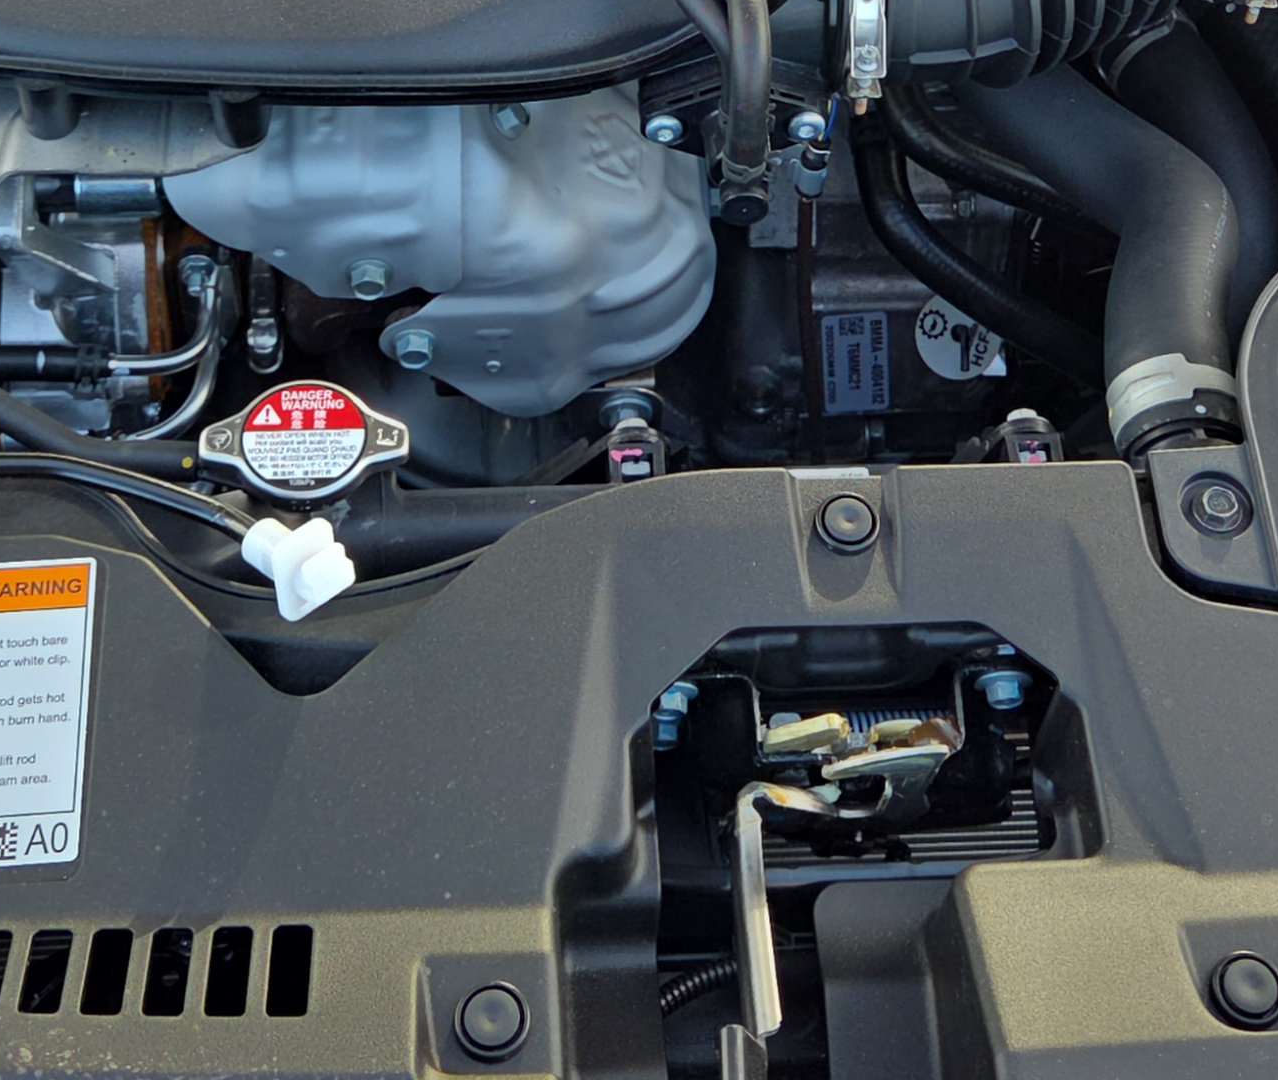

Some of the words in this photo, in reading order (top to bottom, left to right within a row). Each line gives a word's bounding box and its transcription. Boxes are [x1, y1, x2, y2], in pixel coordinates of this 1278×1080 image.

[281, 390, 333, 400] DANGER
[281, 399, 345, 410] WARNUNG
[255, 432, 282, 440] NEVER
[284, 431, 307, 439] OPEN
[7, 636, 39, 648] touch
[41, 635, 69, 646] bare
[14, 655, 44, 667] white
[47, 653, 70, 667] clip.
[17, 694, 43, 707] gets
[46, 692, 65, 703] hot
[8, 715, 35, 725] burn
[38, 712, 71, 723] hand.
[0, 755, 13, 766] lift
[16, 753, 36, 764] rod
[20, 774, 51, 785] area.
[24, 822, 69, 856] A0
